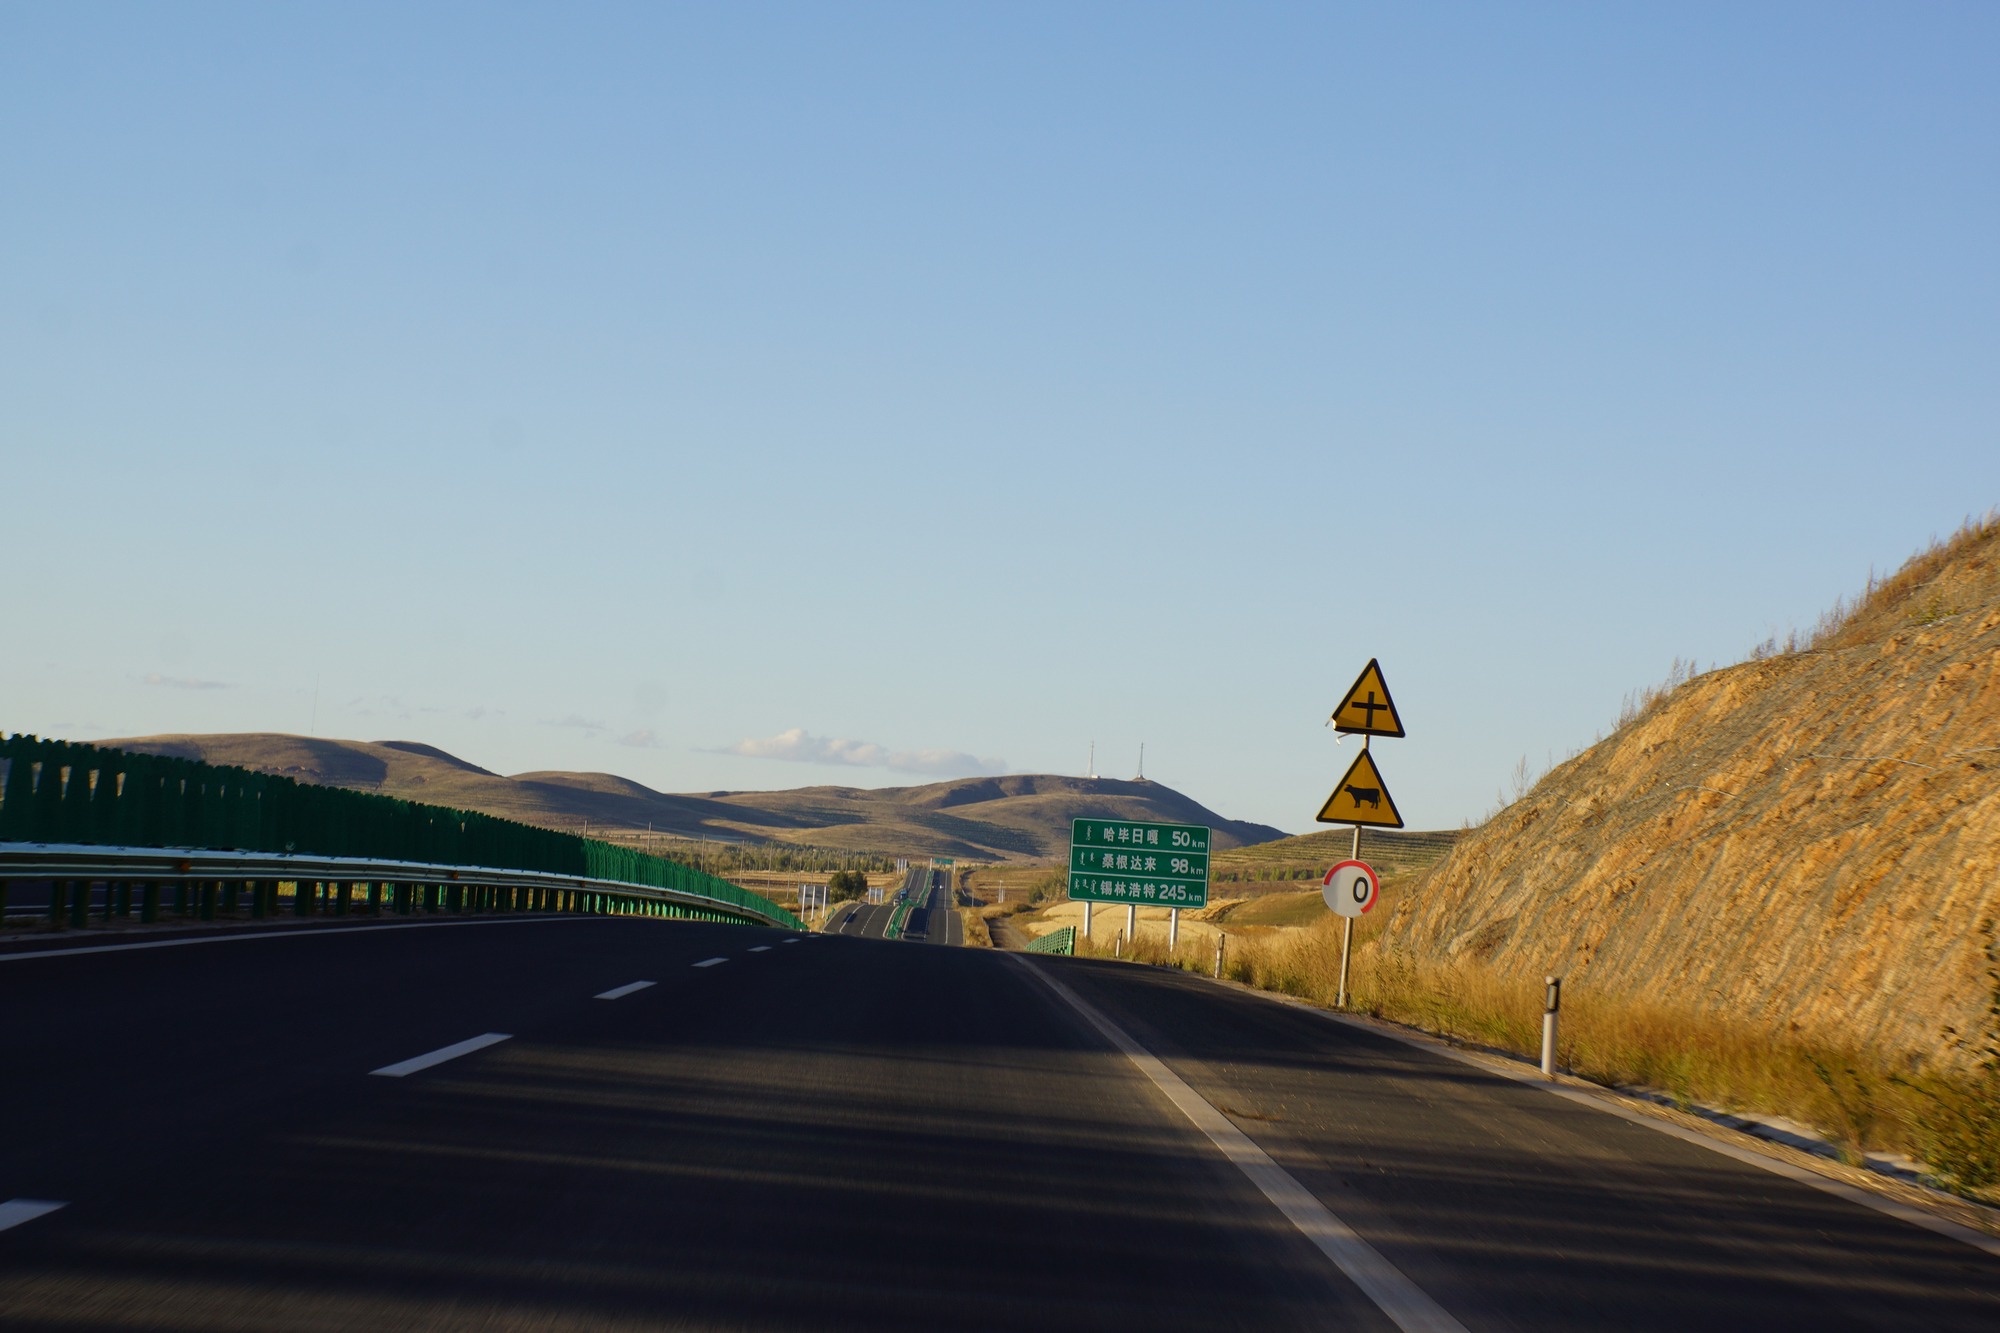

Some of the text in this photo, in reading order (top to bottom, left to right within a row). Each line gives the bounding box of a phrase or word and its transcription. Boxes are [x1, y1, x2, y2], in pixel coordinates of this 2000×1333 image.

[1103, 827, 1159, 845] 哈毕日嘎
[1172, 831, 1190, 847] 50
[1192, 839, 1205, 848] km
[1102, 853, 1157, 872] 桑根达来
[1170, 858, 1189, 874] 98
[1190, 866, 1203, 875] km
[1100, 880, 1156, 899] 锡林浩特
[1159, 884, 1187, 901] 245
[1188, 893, 1202, 902] km
[1353, 877, 1368, 903] 0
